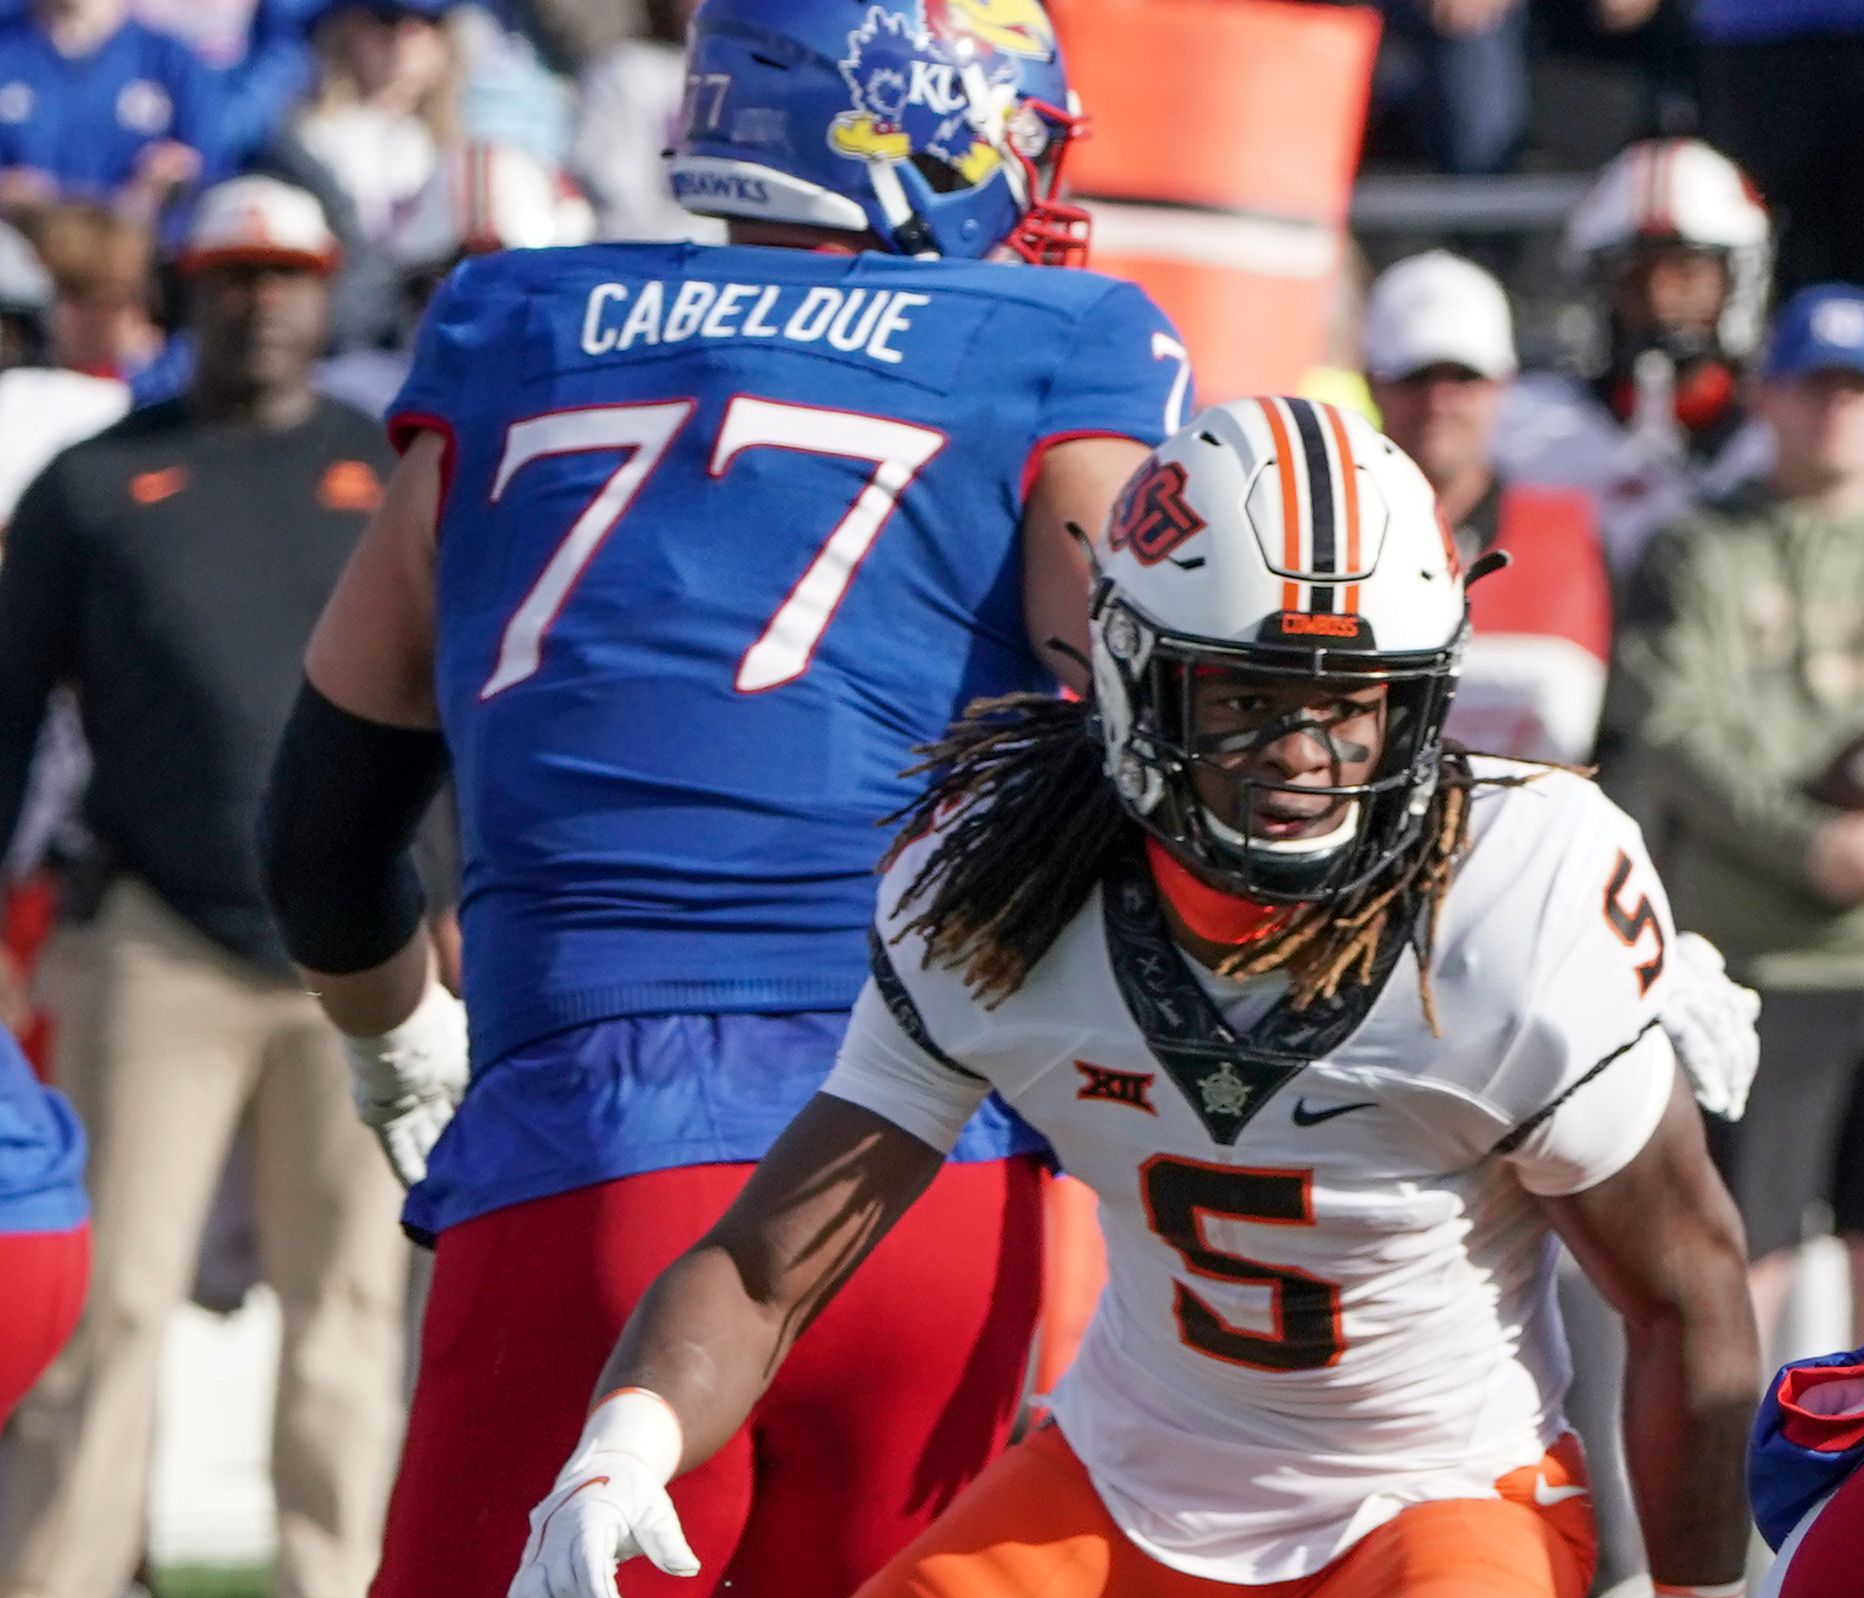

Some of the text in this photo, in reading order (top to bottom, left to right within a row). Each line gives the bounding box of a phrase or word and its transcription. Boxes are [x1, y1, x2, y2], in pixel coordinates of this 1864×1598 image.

[580, 282, 931, 364] CABELDUE
[1151, 331, 1190, 436] 7
[480, 394, 949, 702] 77
[1601, 849, 1665, 998] 5
[1073, 1059, 1160, 1118] XII
[1138, 1151, 1349, 1374] 5
